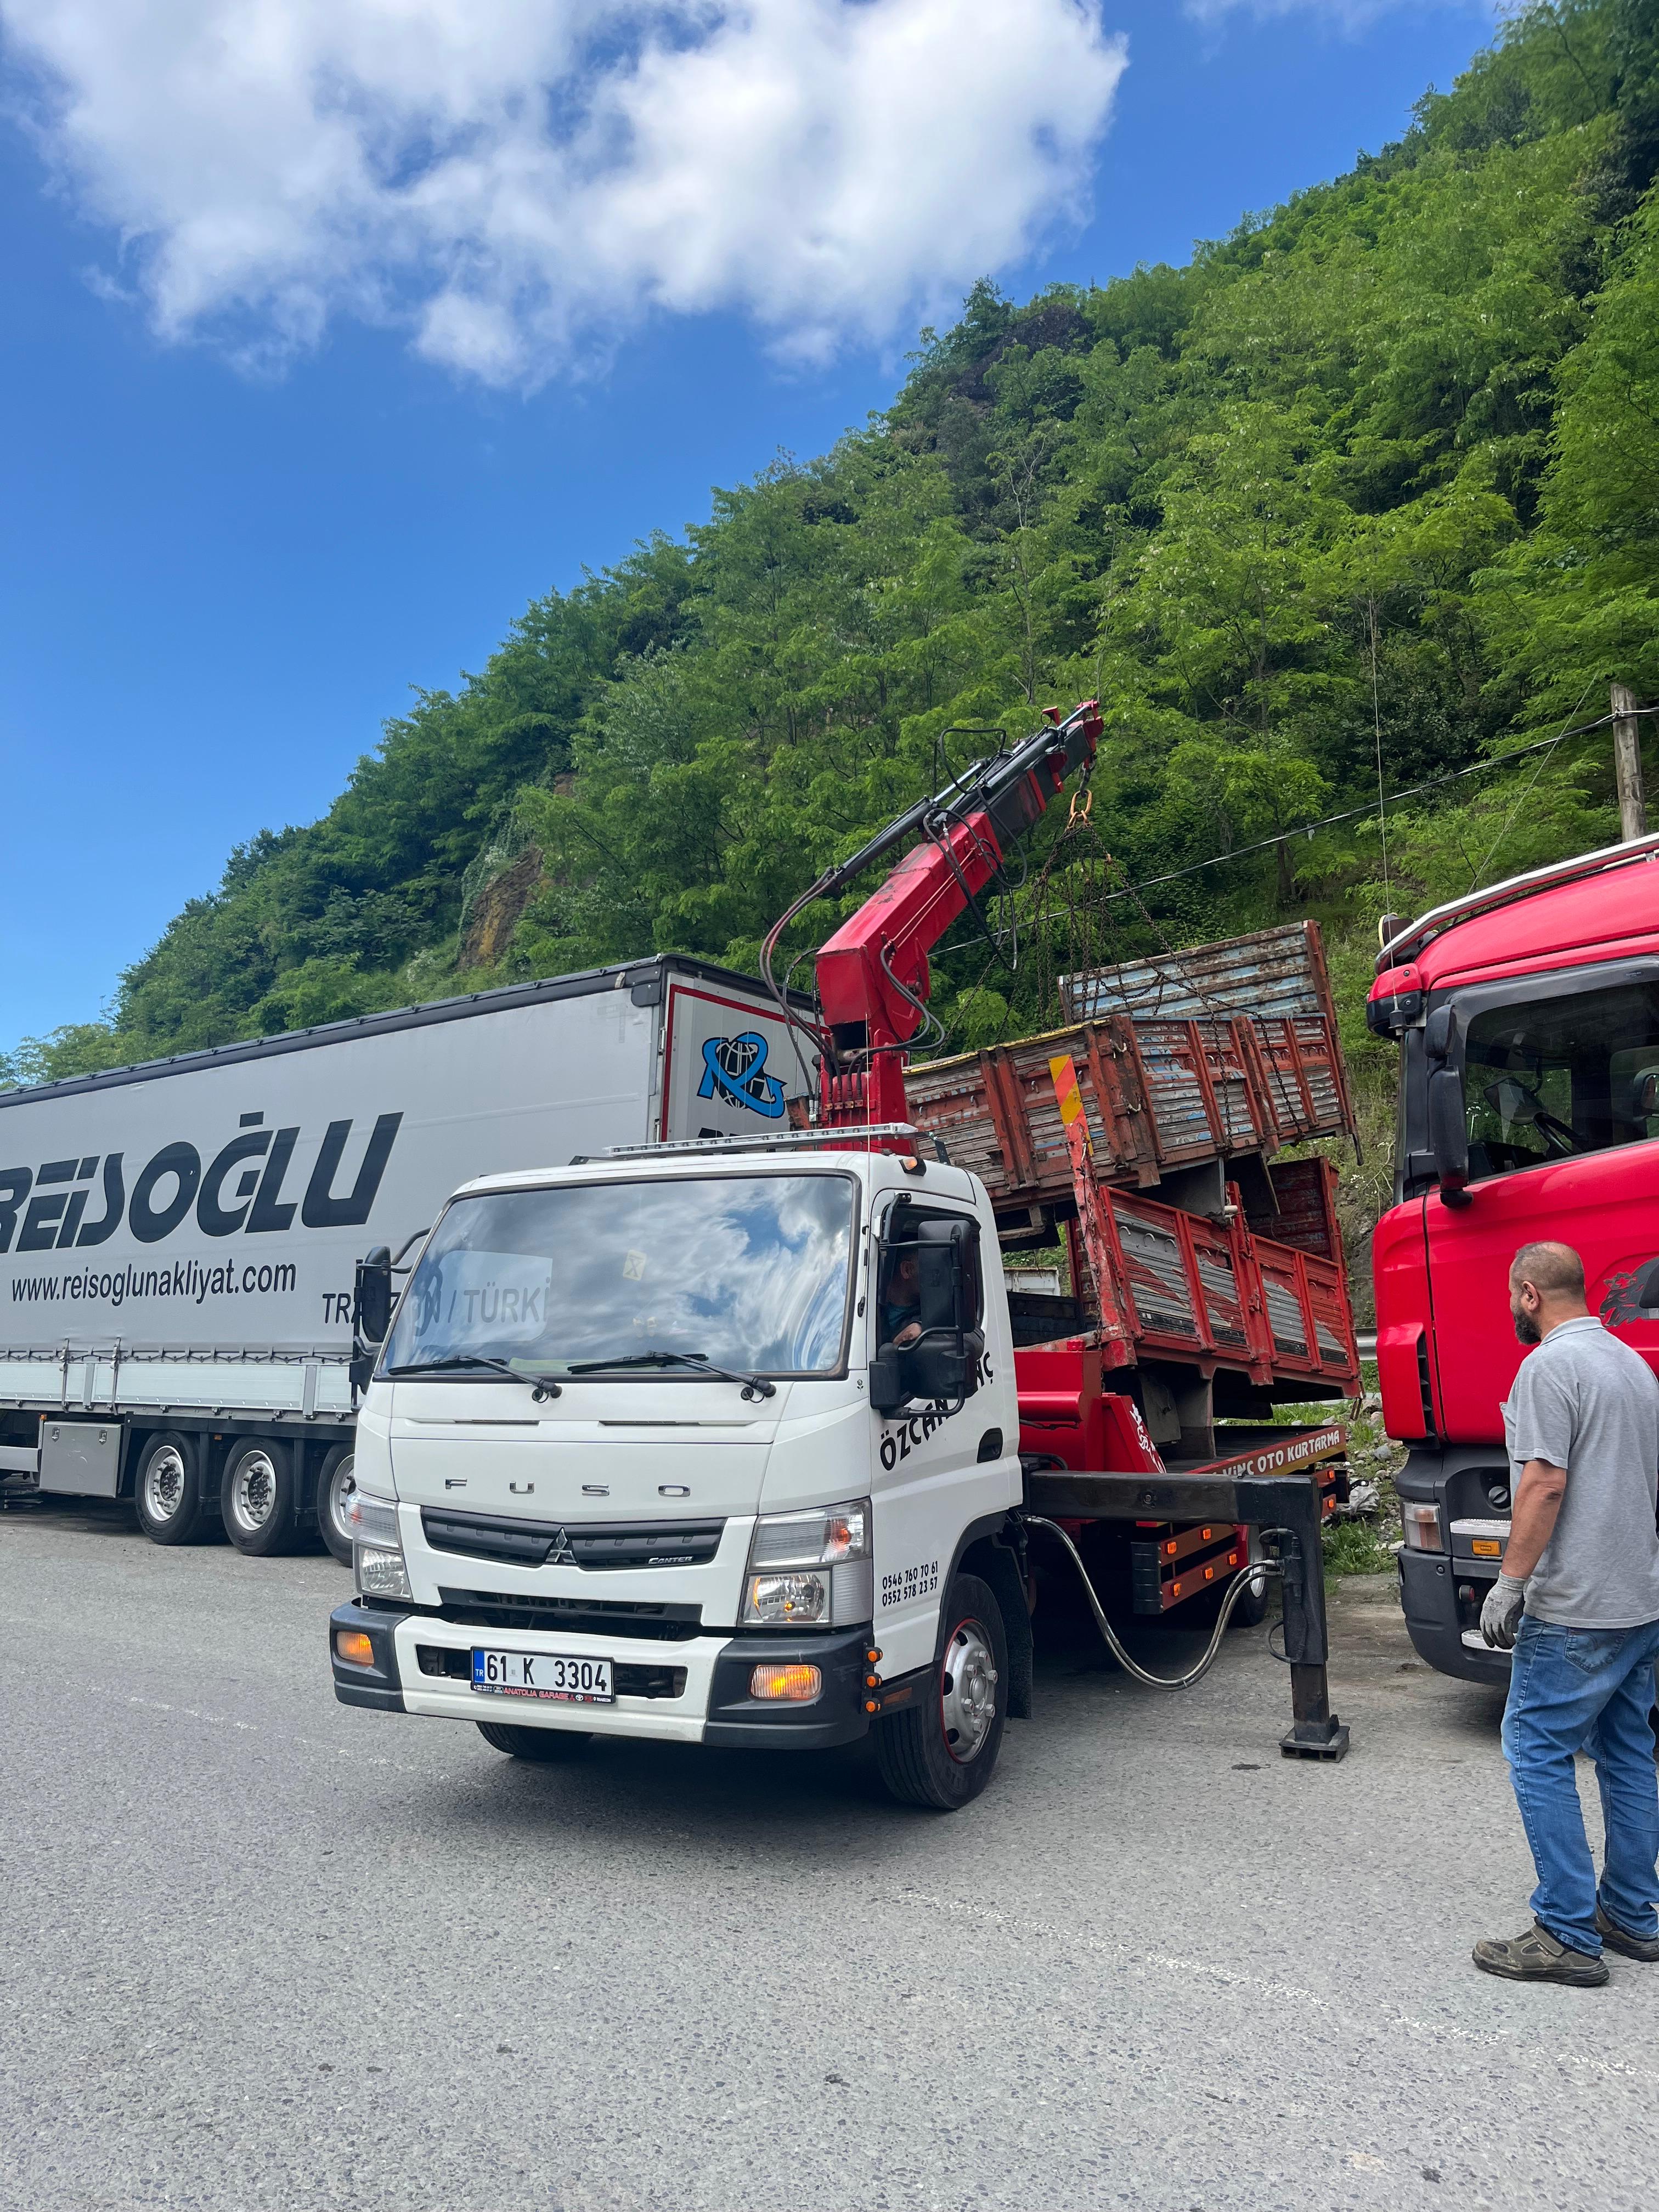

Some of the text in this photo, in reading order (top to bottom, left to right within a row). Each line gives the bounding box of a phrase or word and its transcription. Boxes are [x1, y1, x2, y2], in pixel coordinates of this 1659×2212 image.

[12, 1259, 296, 1306] www.reisoglunakliyat.com
[1257, 1450, 1284, 1472] OTO
[1287, 1430, 1340, 1462] KURTARMA
[445, 1479, 691, 1497] FUSO
[648, 1556, 693, 1564] CANTER
[882, 1561, 938, 1589] 0546 760 70 61
[882, 1576, 938, 1606] 0552 578 23 57
[475, 1654, 607, 1691] TR 61 K 3304
[504, 1687, 537, 1697] ANATOLIA
[539, 1691, 569, 1700] GARAGE
